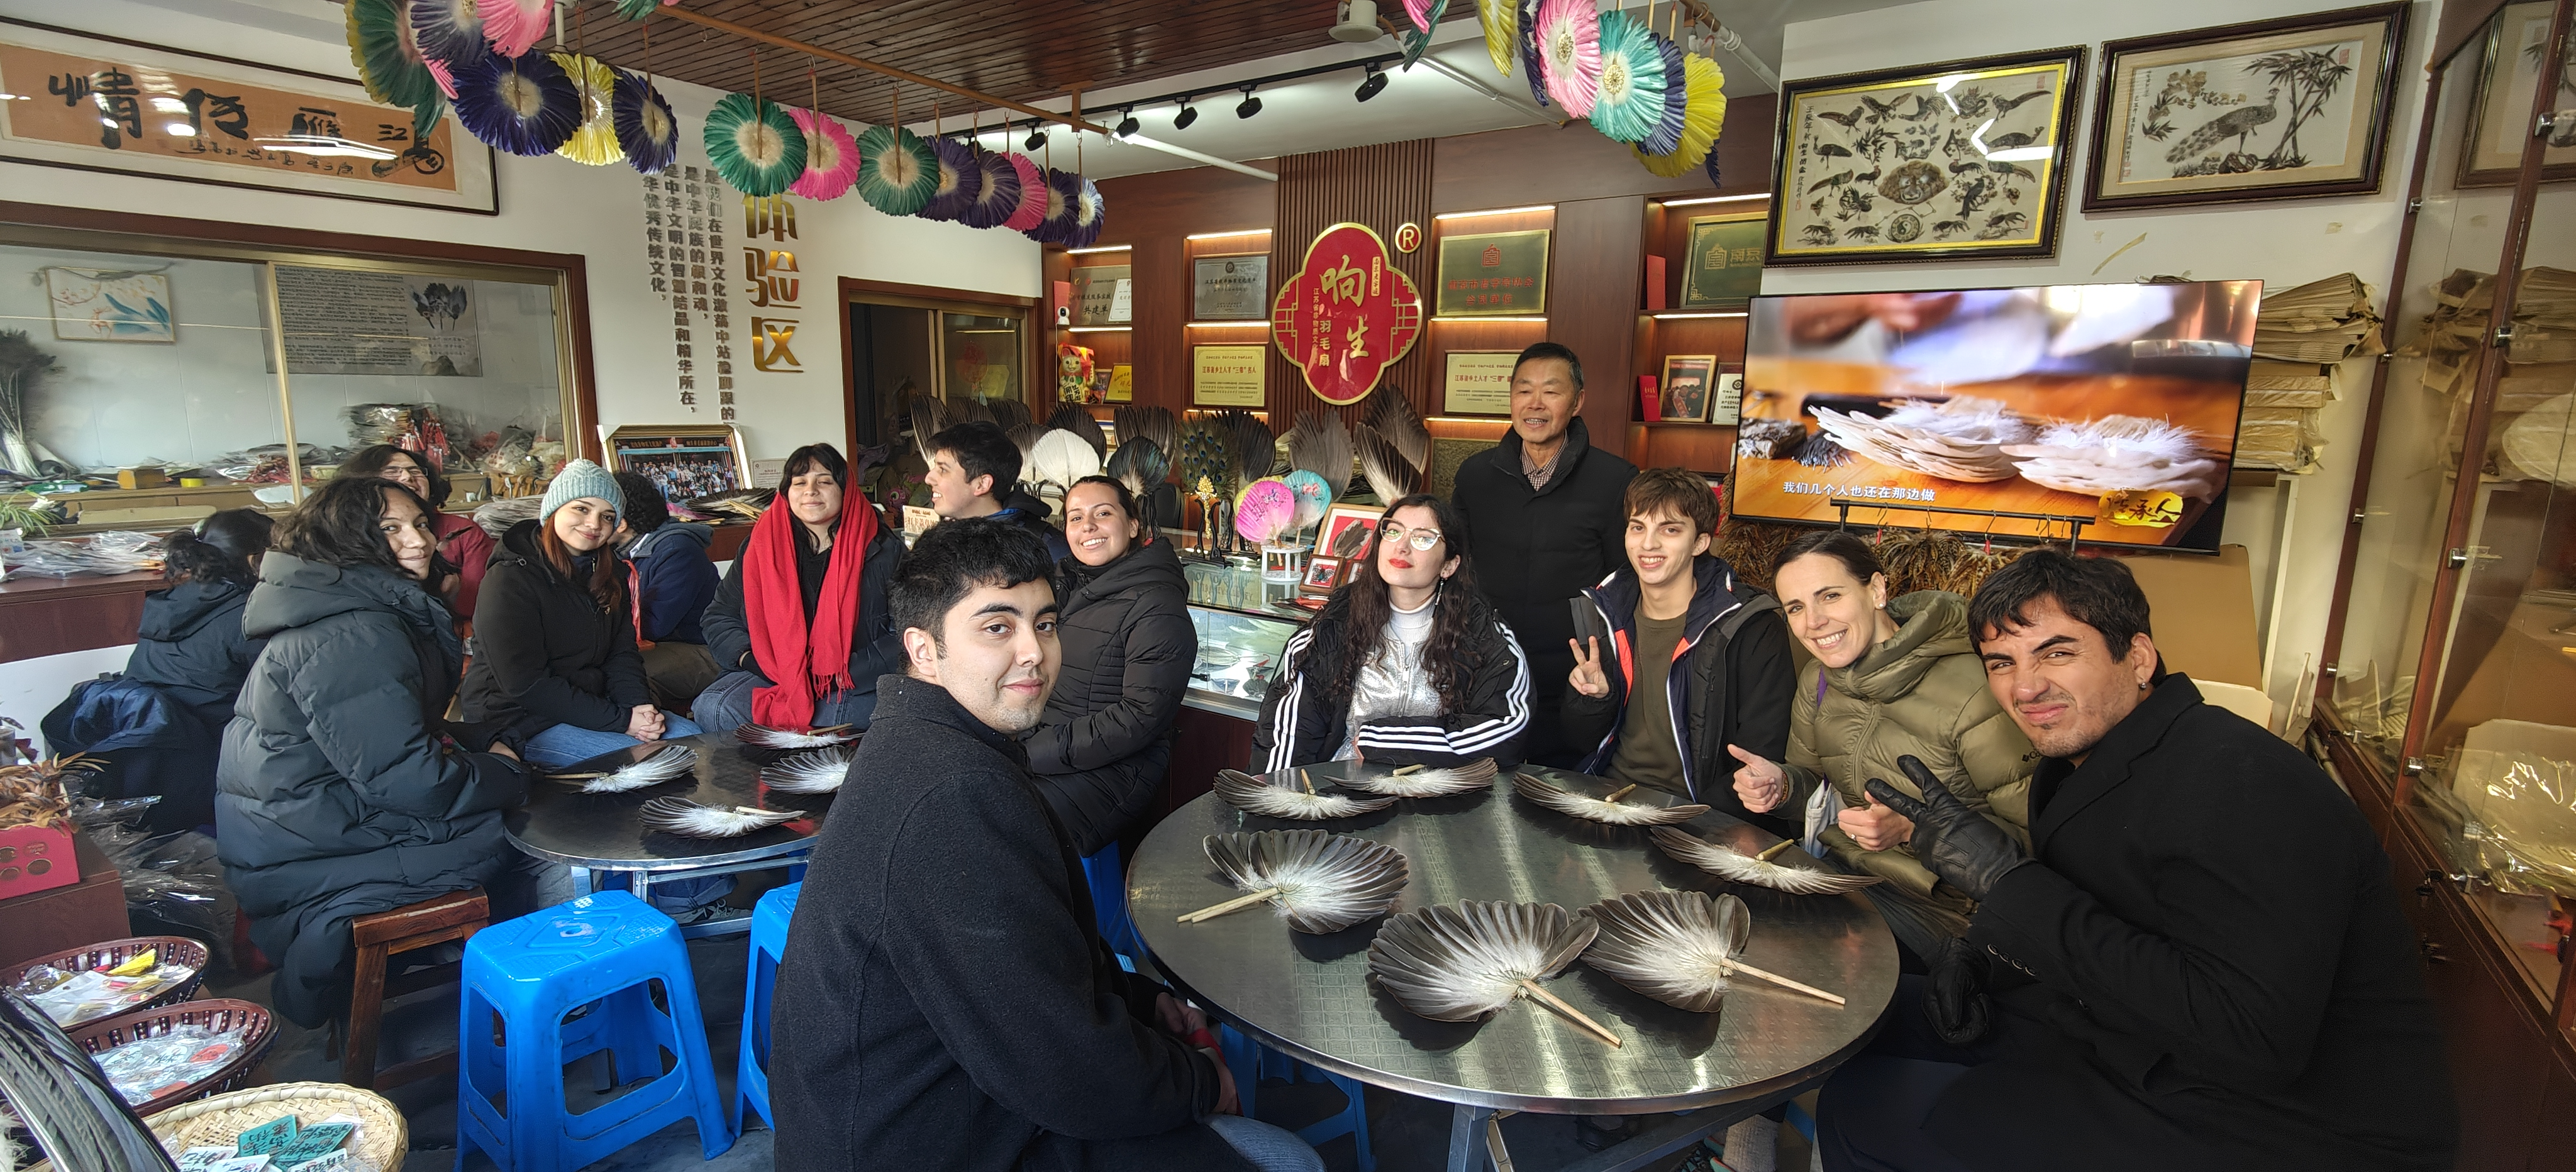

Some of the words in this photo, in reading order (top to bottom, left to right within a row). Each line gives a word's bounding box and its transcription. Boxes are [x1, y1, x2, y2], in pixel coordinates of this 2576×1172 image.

[704, 169, 735, 422] 是我们在世界文化激荡中站稳脚跟的
[742, 193, 804, 373] 体验区
[1448, 276, 1534, 290] 南京市老字号协会
[1466, 293, 1513, 306] 会员单位
[1319, 255, 1370, 359] 响生
[1319, 320, 1331, 366] 羽毛扇
[1782, 481, 1936, 502] 我们几个人也还在那边做
